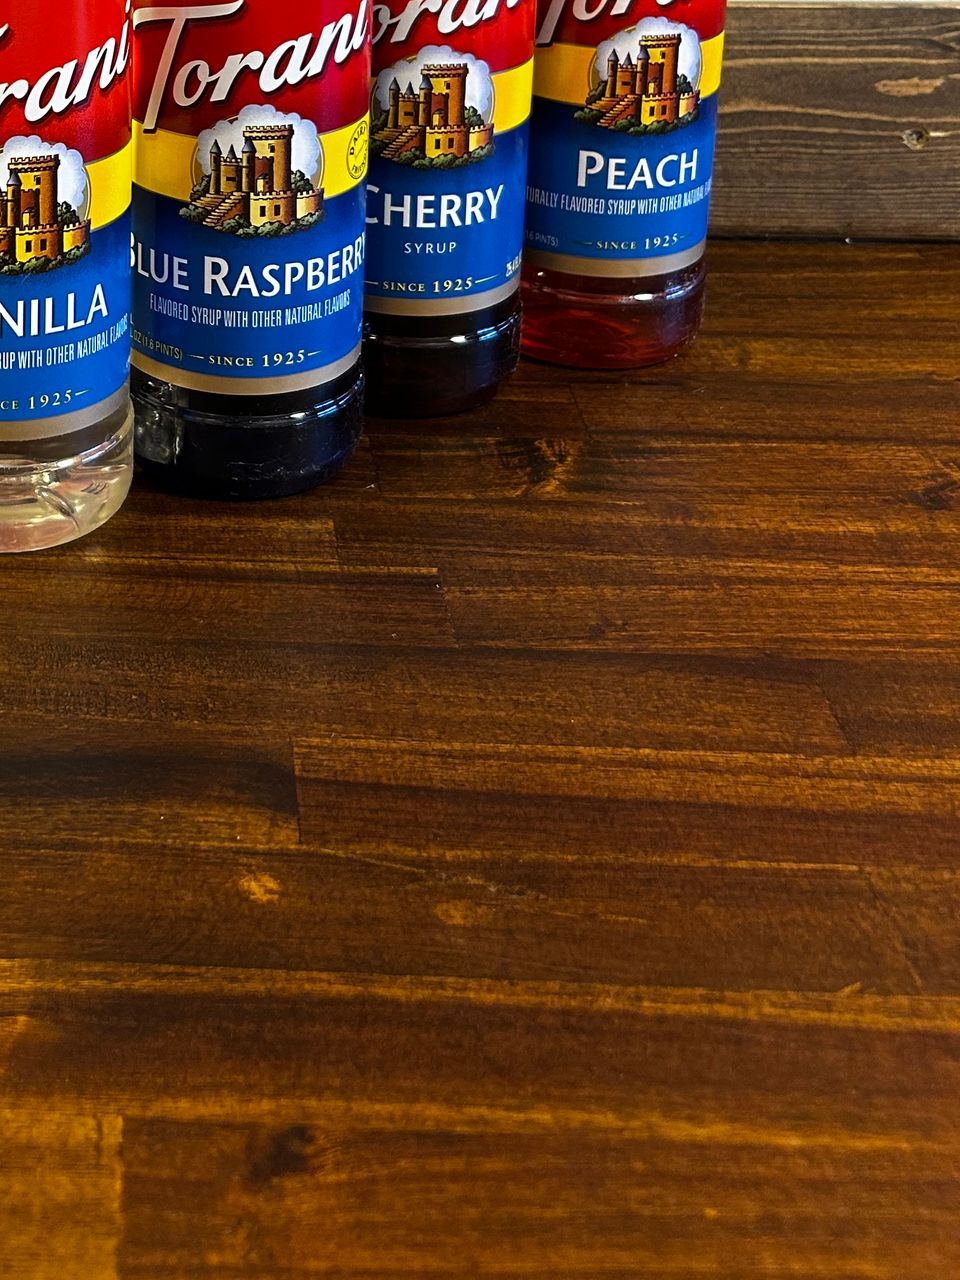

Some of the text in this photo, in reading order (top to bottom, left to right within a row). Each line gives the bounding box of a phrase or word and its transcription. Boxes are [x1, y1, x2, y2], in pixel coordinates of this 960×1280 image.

[577, 148, 698, 191] PEACH
[560, 193, 605, 215] FLAVORED
[607, 198, 636, 215] SYRUP
[637, 198, 657, 215] WITH
[659, 195, 682, 213] OTHER
[403, 241, 457, 254] SYRUP
[596, 234, 678, 250] SINCE 1925
[382, 276, 473, 293] SINCE 1925
[150, 288, 351, 328] FLAVORED SYRUP WITH OTHER NATURAL FLAVORS
[17, 349, 43, 369] WITH
[46, 343, 74, 366] OTHER
[76, 329, 109, 359] NATURAL
[155, 341, 183, 361] PINTS)
[208, 349, 305, 367] SINCE 1925
[28, 389, 72, 410] 1925
